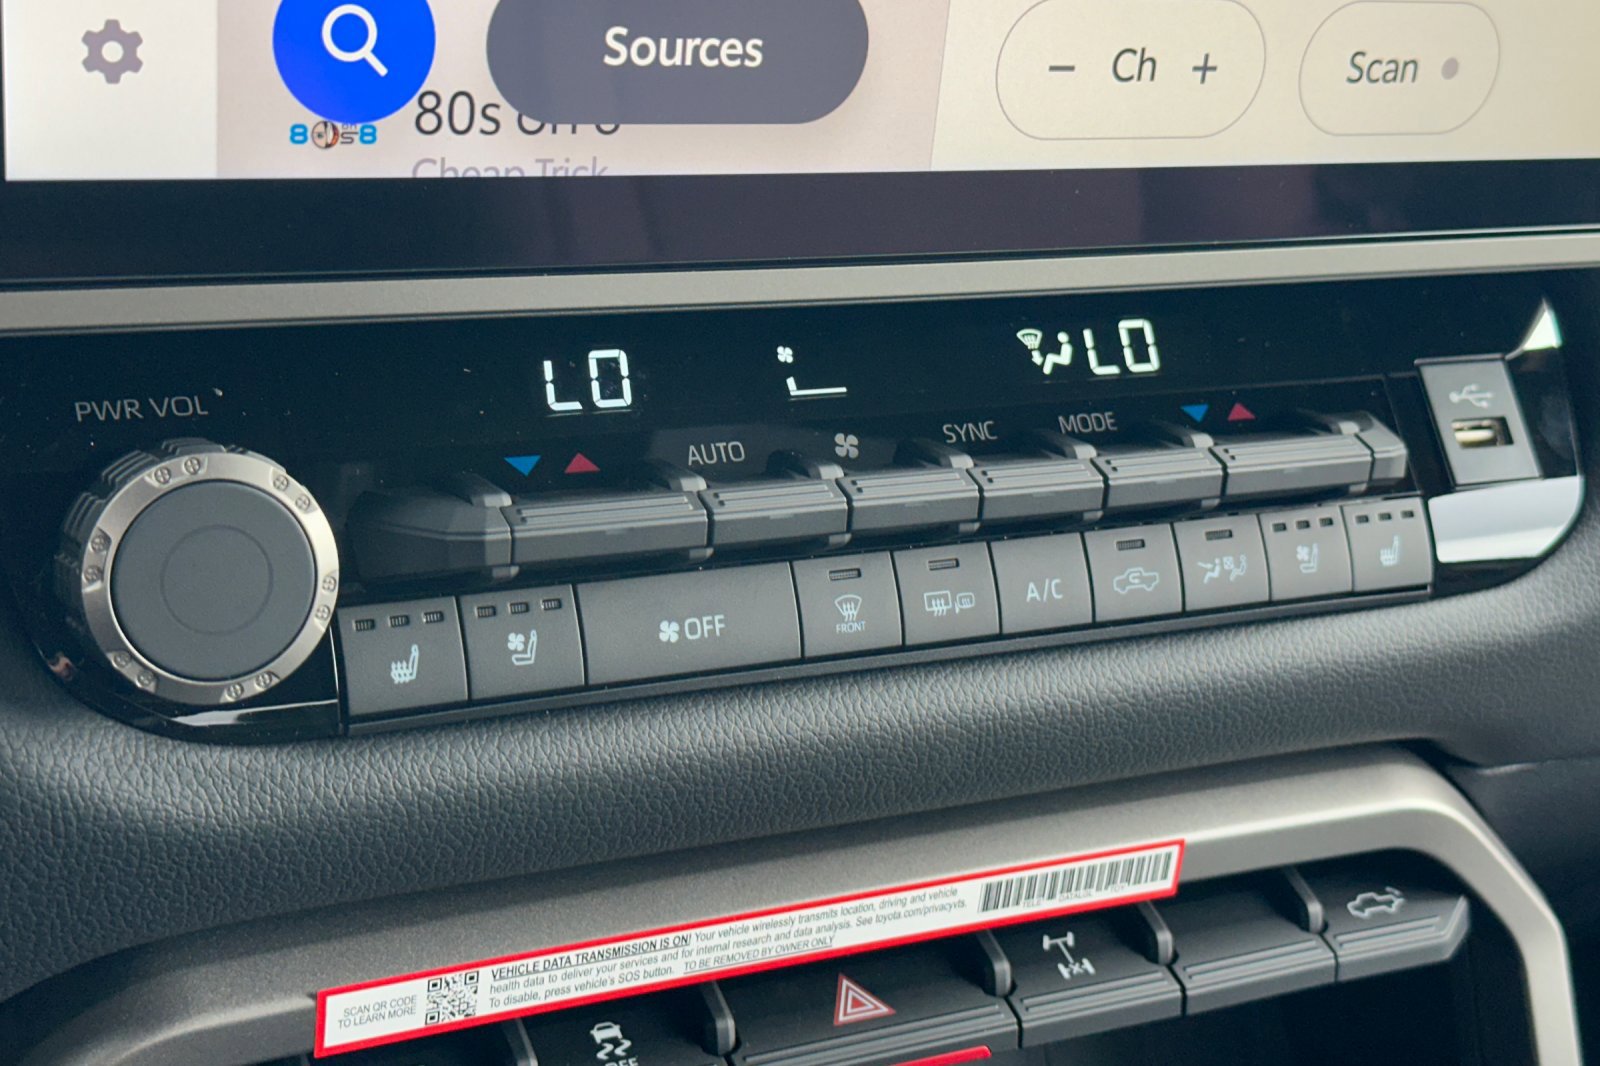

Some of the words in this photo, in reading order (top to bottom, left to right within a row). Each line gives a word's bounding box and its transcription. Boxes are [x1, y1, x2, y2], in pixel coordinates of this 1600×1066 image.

[603, 25, 763, 68] Sources
[1112, 47, 1157, 83] Ch
[1345, 50, 1419, 84] Scan
[414, 90, 501, 136] 80s
[535, 156, 608, 177] Trick
[1082, 318, 1160, 375] LO
[543, 349, 632, 411] LO
[75, 399, 144, 422] PWR
[149, 396, 208, 417] VOL
[1058, 411, 1118, 434] MODE
[942, 420, 998, 443] SYNC
[688, 441, 745, 466] AUTO
[1026, 578, 1063, 602] A/C
[685, 614, 725, 640] OFF
[836, 620, 866, 634] FRONT
[491, 961, 540, 980] VEHICLE
[543, 955, 571, 970] DATA
[575, 940, 657, 965] TRANSMISSION
[660, 939, 669, 948] IS
[673, 934, 692, 946] ON!
[695, 931, 715, 942] Your
[718, 924, 749, 937] vehicle
[752, 915, 796, 931] wirelessly
[799, 909, 838, 923] transmits
[840, 902, 875, 916] location,
[879, 896, 907, 909] driving
[910, 892, 926, 901] and
[928, 887, 958, 900] vehicle
[490, 980, 520, 994] health
[523, 975, 545, 987] data
[548, 973, 558, 983] to
[561, 967, 593, 980] deliver
[596, 963, 617, 975] your
[620, 957, 658, 970] services
[661, 951, 679, 962] and
[681, 948, 694, 959] for
[696, 941, 730, 956] internal
[732, 934, 771, 949] research
[774, 930, 791, 941] and
[793, 926, 813, 938] data
[815, 919, 852, 934] analysis.
[856, 916, 873, 927] See
[684, 961, 696, 971] TO
[699, 958, 711, 968] BE
[714, 949, 760, 965] REMOVED
[762, 946, 775, 957] BY
[775, 940, 809, 954] OWNER
[810, 936, 834, 948] ONLY
[489, 997, 501, 1009] To
[503, 992, 541, 1006] disable,
[544, 986, 571, 999] press
[618, 970, 640, 984] SOS
[643, 966, 674, 979] button.
[337, 1018, 351, 1030] TO
[353, 1012, 386, 1026] LEARN
[388, 1006, 417, 1019] MORE
[343, 1003, 371, 1018] SCAN
[373, 1000, 387, 1012] QR
[389, 995, 417, 1009] CODE
